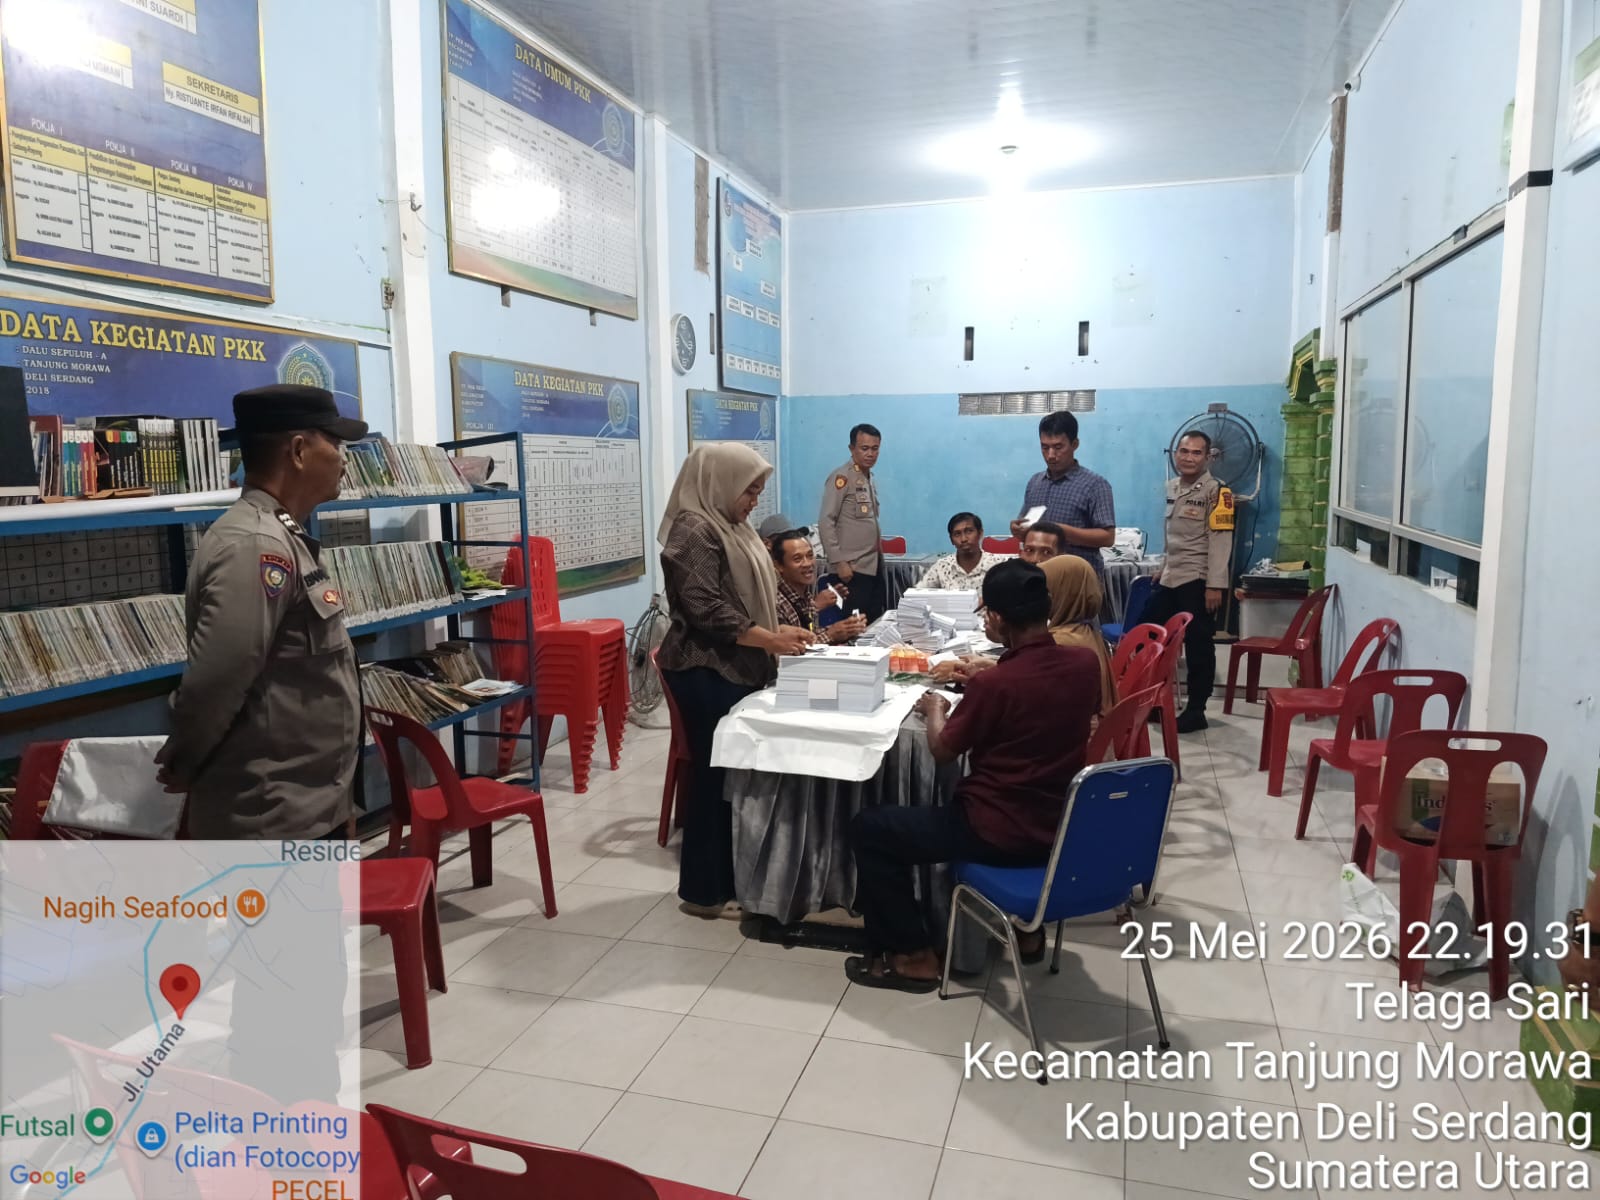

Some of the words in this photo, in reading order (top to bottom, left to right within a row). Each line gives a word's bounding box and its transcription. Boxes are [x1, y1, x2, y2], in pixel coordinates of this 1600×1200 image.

[150, 1, 184, 24] SUARDI
[514, 43, 542, 73] DATA
[543, 61, 572, 91] UMUM
[574, 80, 591, 104] PKK
[186, 75, 240, 104] SEKRETARIS
[31, 118, 55, 135] POKJA
[0, 308, 83, 343] DATA
[89, 319, 217, 357] KEGIATAN
[223, 337, 267, 362] PKK
[22, 345, 48, 355] DALU
[51, 347, 93, 359] SEPULUH
[100, 352, 107, 360] A
[24, 359, 69, 370] TANJUNG
[71, 362, 111, 373] MORAWA
[25, 372, 48, 381] DELI
[51, 374, 94, 385] SERDANG
[514, 370, 541, 388] DATA
[543, 374, 587, 395] KEGIATAN
[587, 382, 604, 397] PKK
[26, 385, 50, 395] 2018
